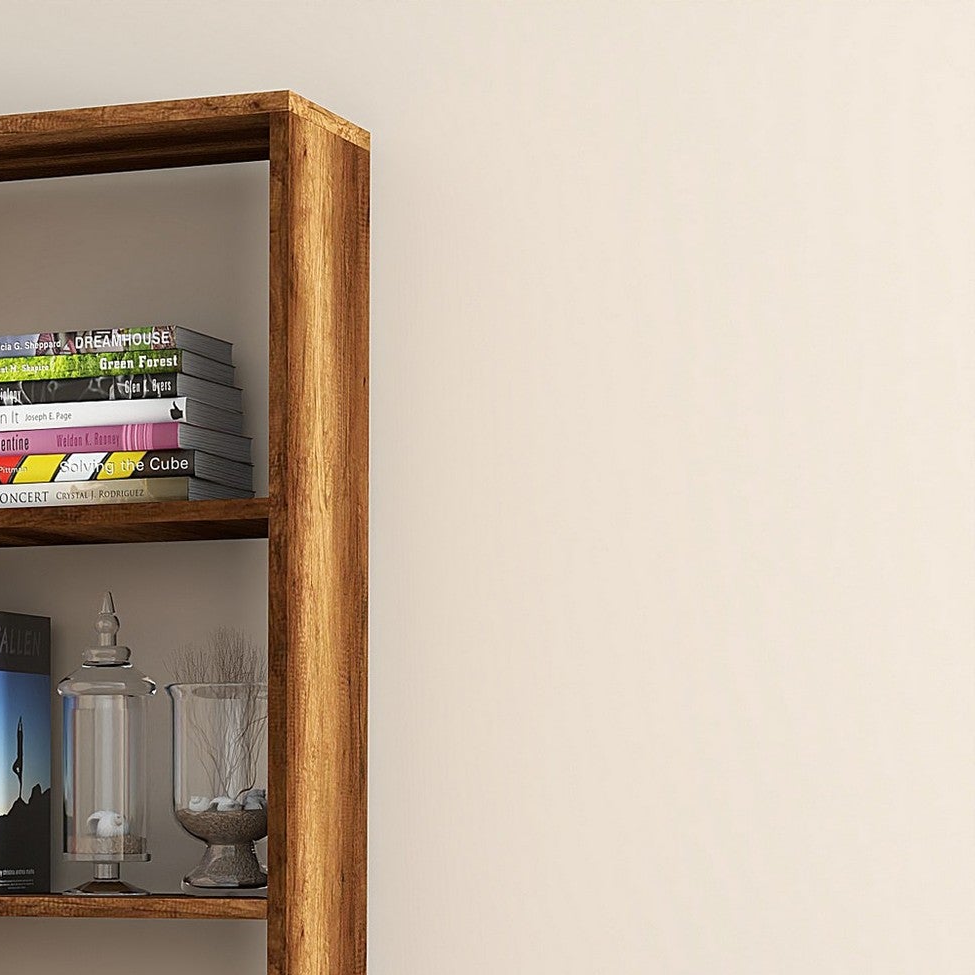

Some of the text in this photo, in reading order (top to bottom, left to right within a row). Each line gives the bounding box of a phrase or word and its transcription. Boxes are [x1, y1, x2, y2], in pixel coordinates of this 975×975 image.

[13, 341, 23, 350] G.
[24, 340, 62, 351] Sheppard
[74, 331, 170, 349] DREAMHOUSE
[21, 364, 50, 374] Shapiro
[99, 355, 178, 371] Green Forest
[124, 379, 141, 394] Glen
[152, 379, 171, 397] Byers
[11, 410, 19, 424] It
[25, 411, 72, 422] Joseph E. Page
[56, 432, 120, 448] Weldon K. Rooney
[59, 456, 189, 475] Solving the Cube
[55, 489, 145, 501] CRYSTAL J. RODRIGUEZ
